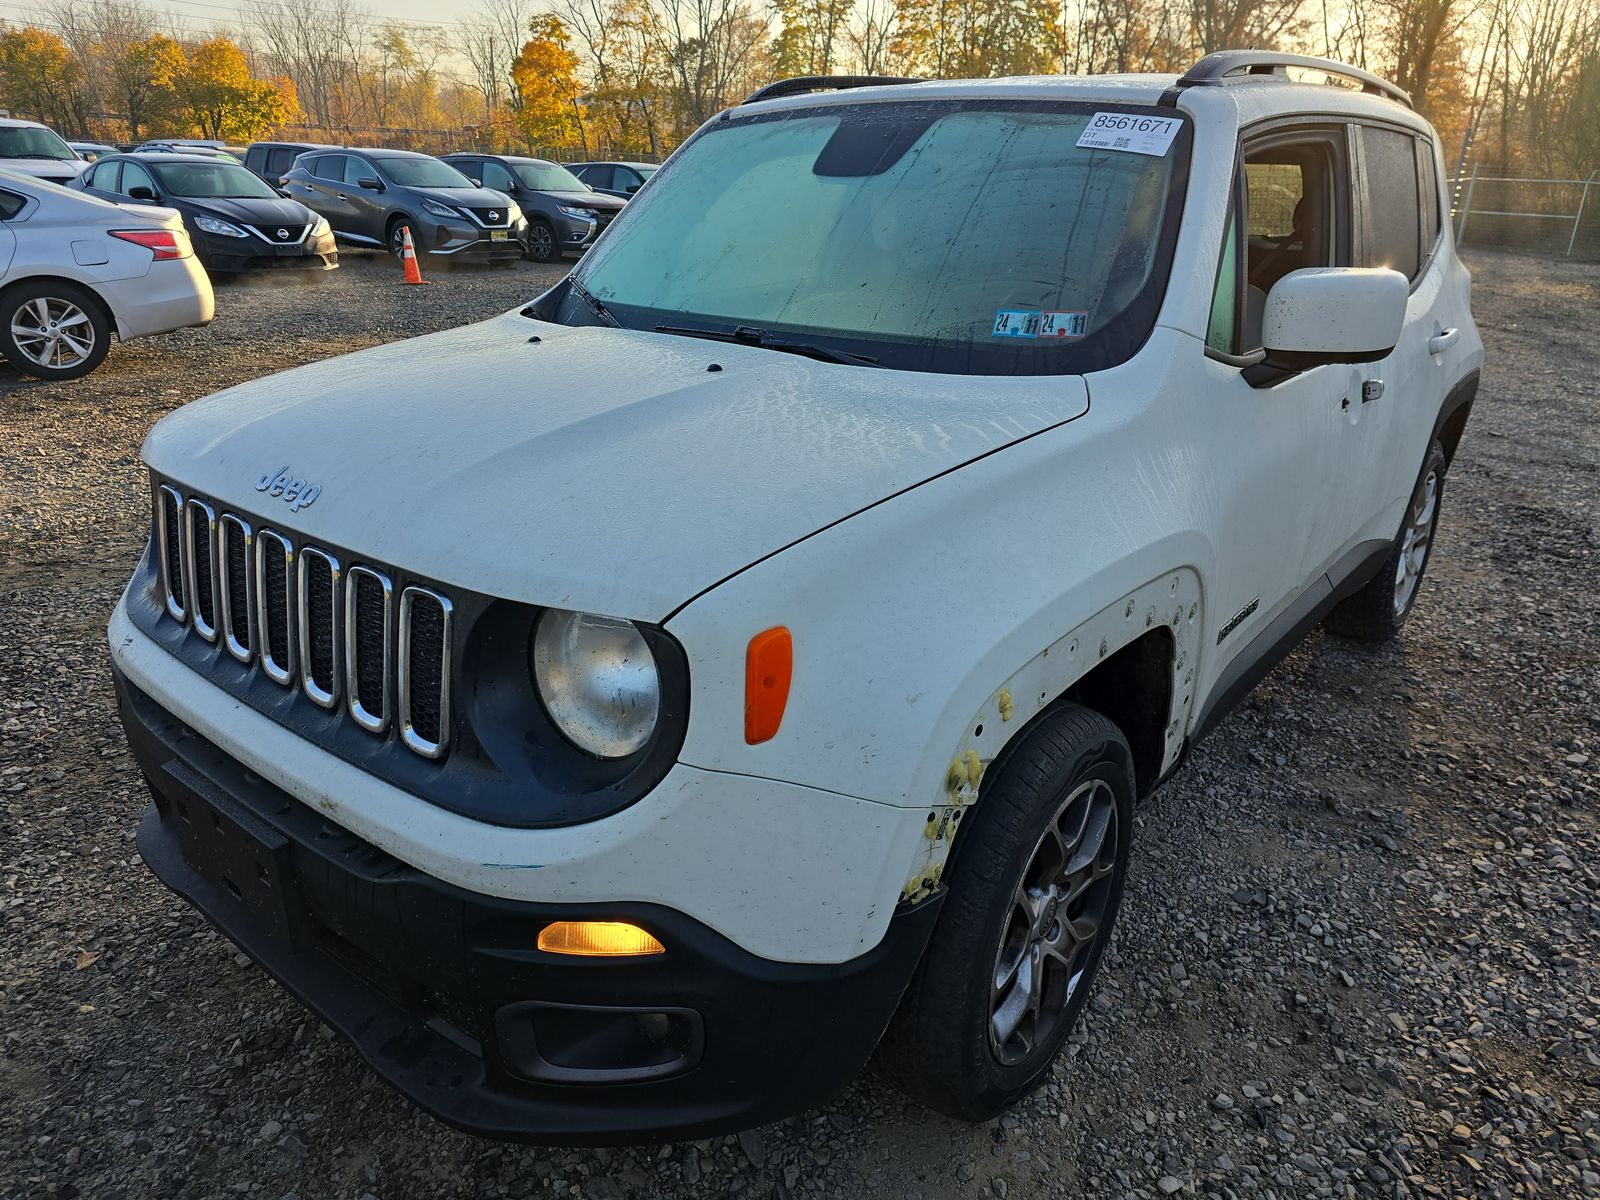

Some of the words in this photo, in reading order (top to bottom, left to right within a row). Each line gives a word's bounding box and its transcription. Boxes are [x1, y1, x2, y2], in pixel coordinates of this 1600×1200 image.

[1094, 115, 1173, 134] 8561671
[995, 313, 1010, 332] 24
[1026, 318, 1039, 334] 11
[1042, 314, 1055, 333] 24
[1073, 314, 1086, 334] 11
[255, 464, 322, 513] Jeep
